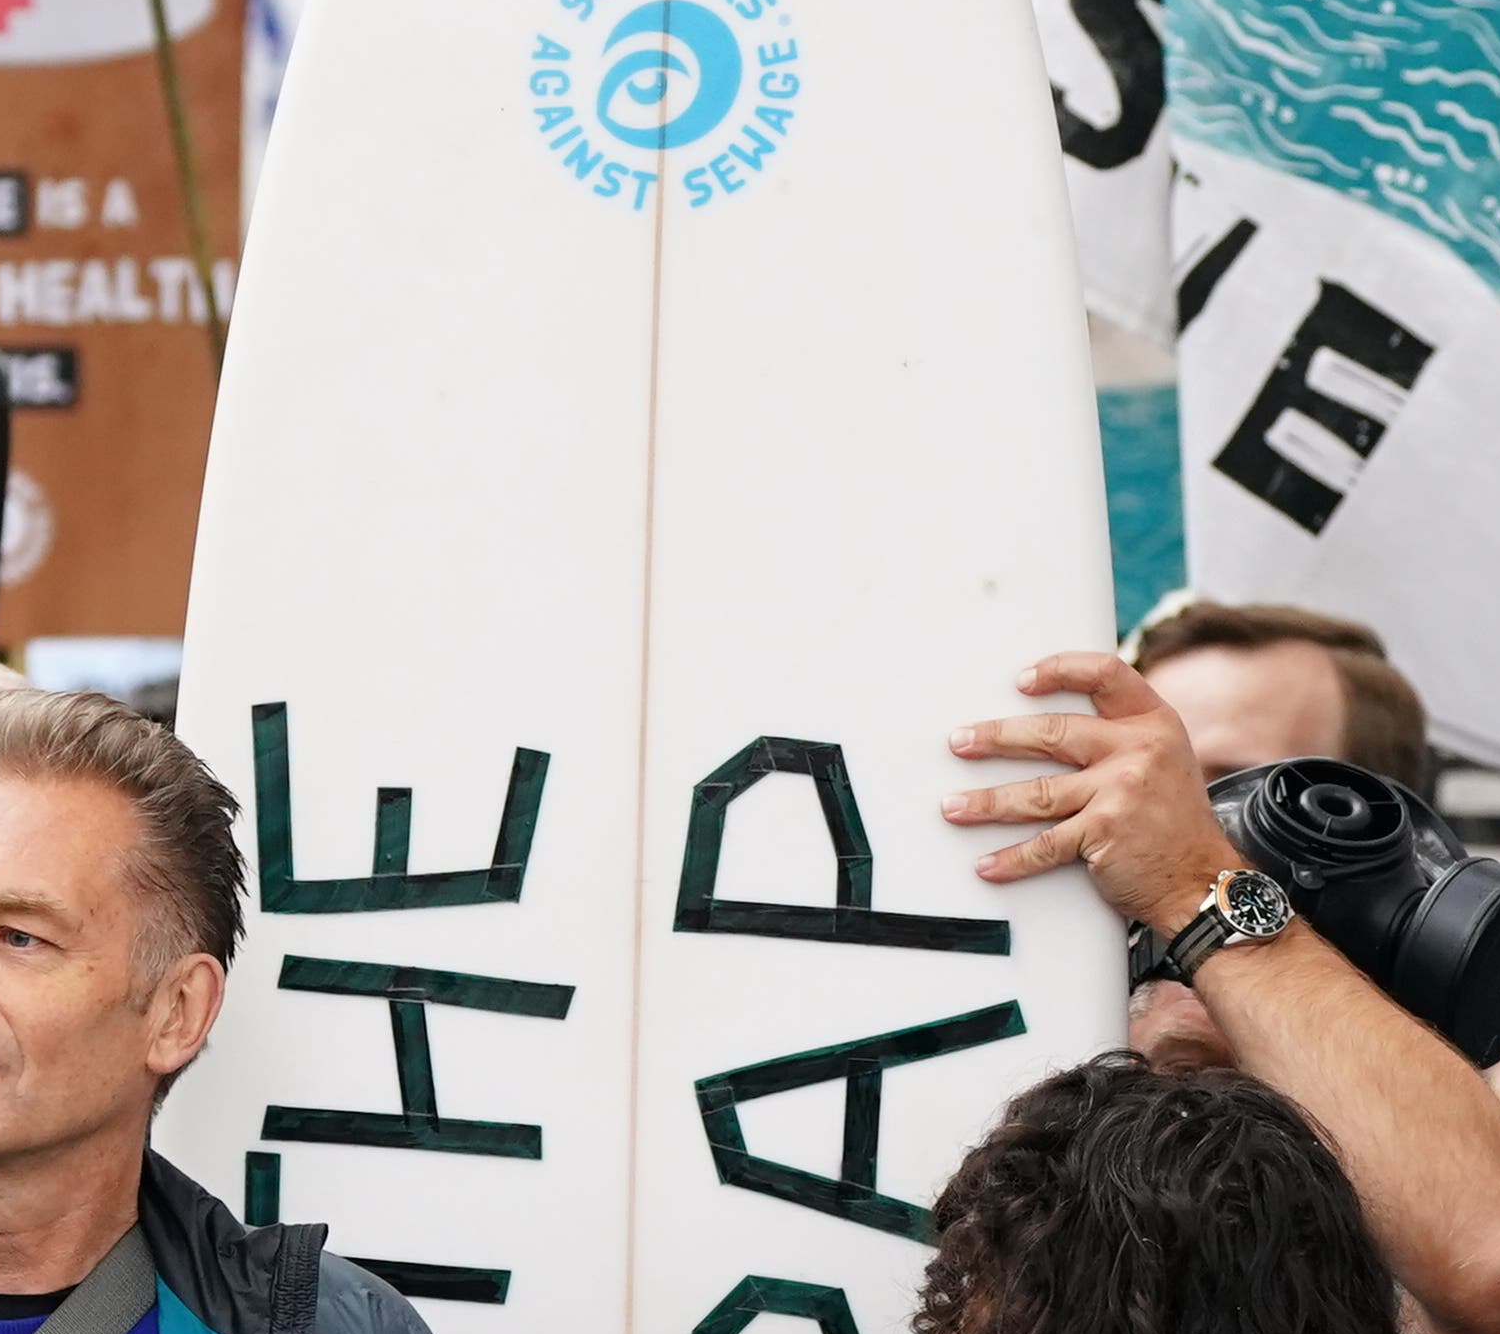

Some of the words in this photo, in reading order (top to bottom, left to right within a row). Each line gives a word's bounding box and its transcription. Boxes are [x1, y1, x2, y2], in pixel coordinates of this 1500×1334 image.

[35, 177, 87, 229] IS
[102, 178, 138, 228] A
[529, 33, 660, 211] AGAINST
[682, 38, 801, 209] SEWAGE
[246, 701, 576, 1304] THE
